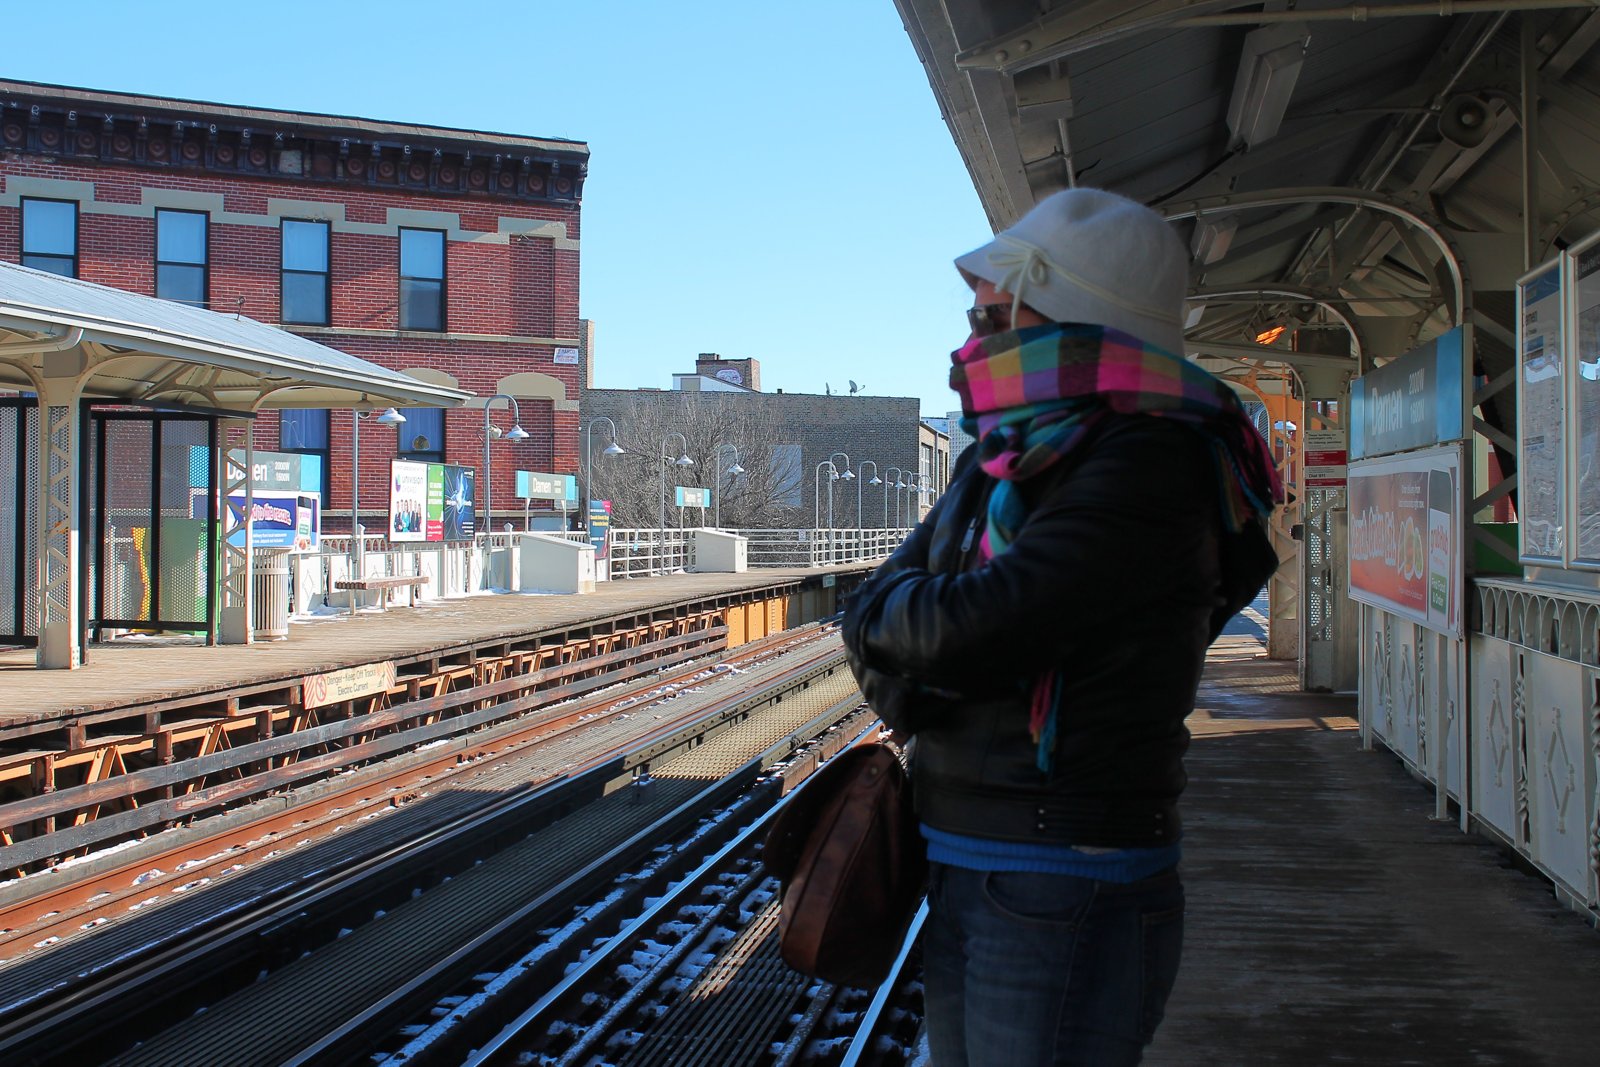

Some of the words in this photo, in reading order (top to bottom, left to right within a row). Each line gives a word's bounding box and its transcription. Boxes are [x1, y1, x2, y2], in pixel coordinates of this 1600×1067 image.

[1371, 387, 1403, 437] Damen
[227, 461, 267, 481] Daen
[532, 477, 552, 494] Damen
[337, 684, 353, 696] Electric
[353, 682, 369, 692] Current
